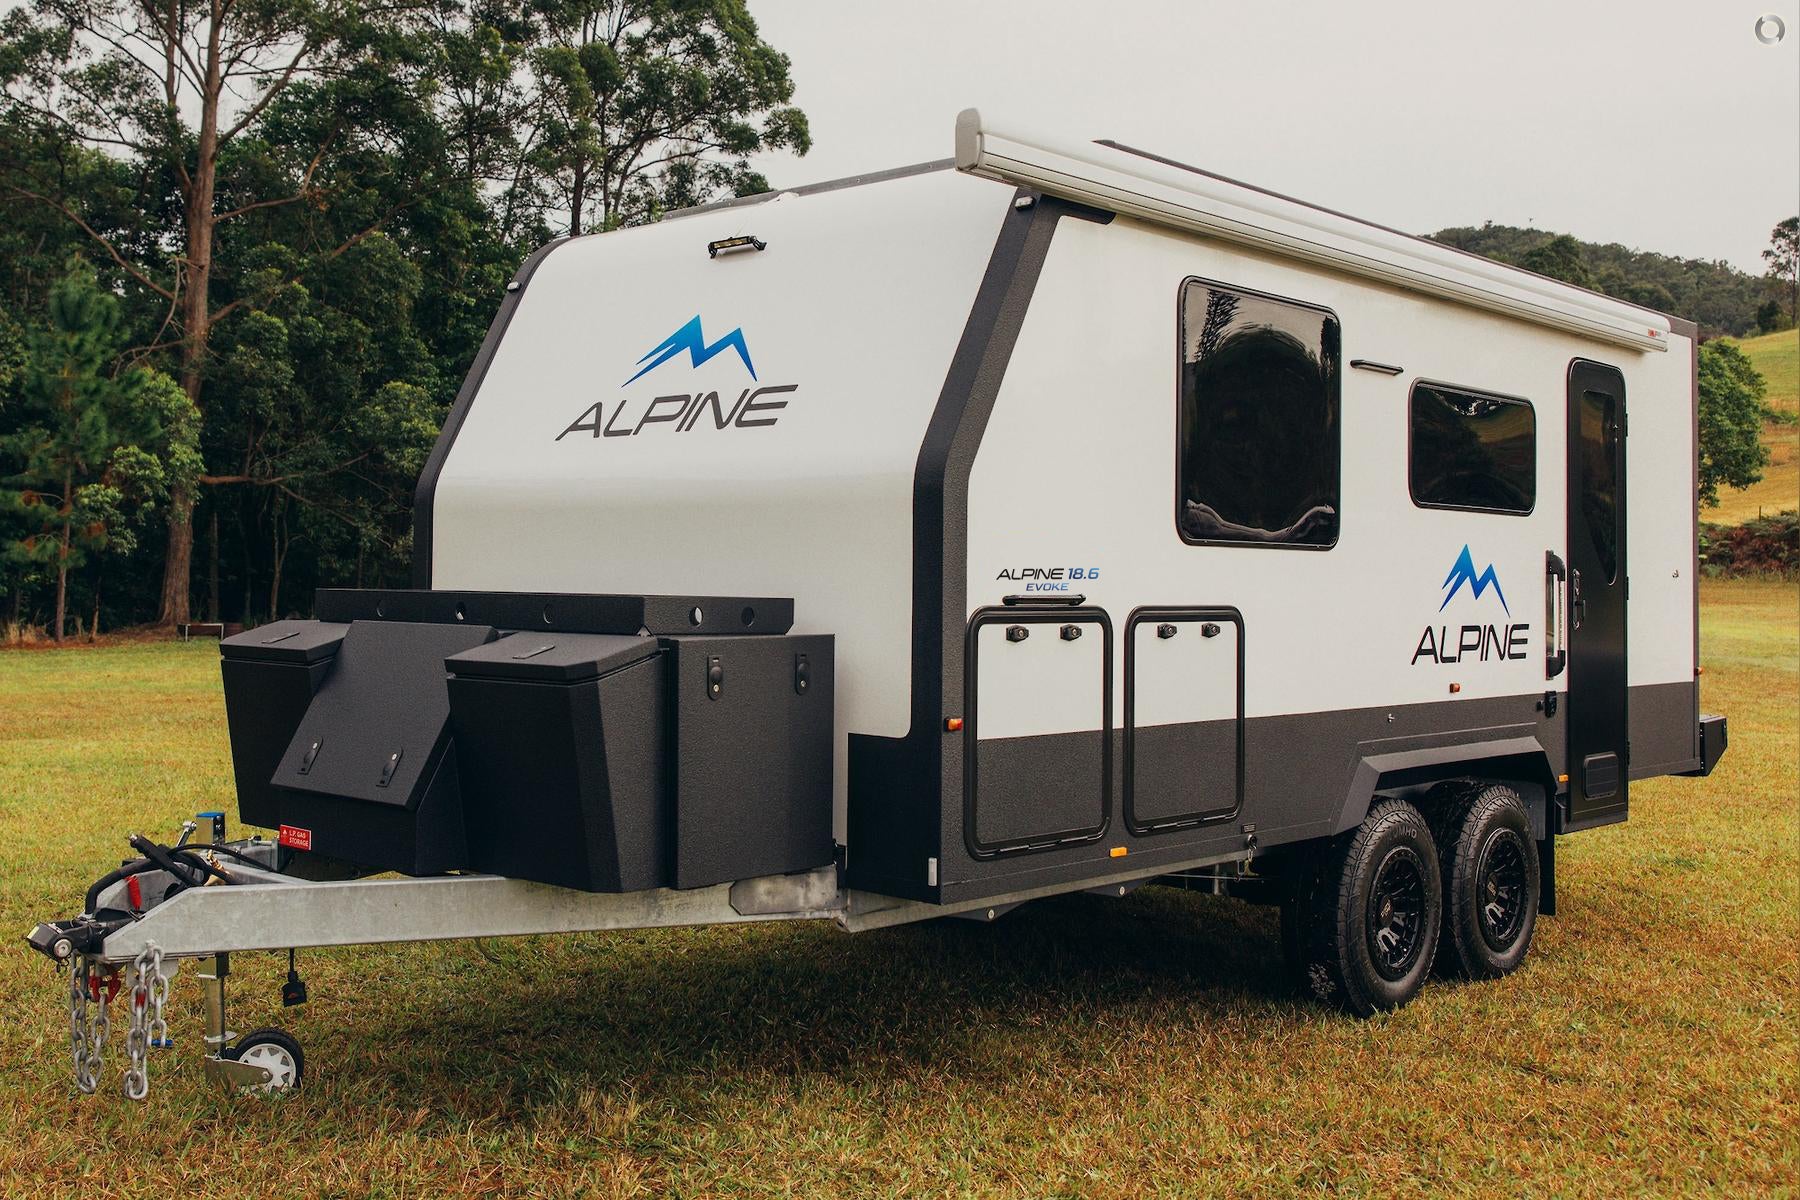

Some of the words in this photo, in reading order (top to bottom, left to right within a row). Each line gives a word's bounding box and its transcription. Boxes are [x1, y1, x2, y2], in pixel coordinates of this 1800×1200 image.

[555, 384, 798, 441] ALPINE
[996, 568, 1064, 580] ALPINE
[1068, 568, 1099, 580] 18.6
[1026, 583, 1069, 591] EVOKE
[1411, 623, 1529, 666] ALPINE
[289, 837, 309, 847] STORAGE
